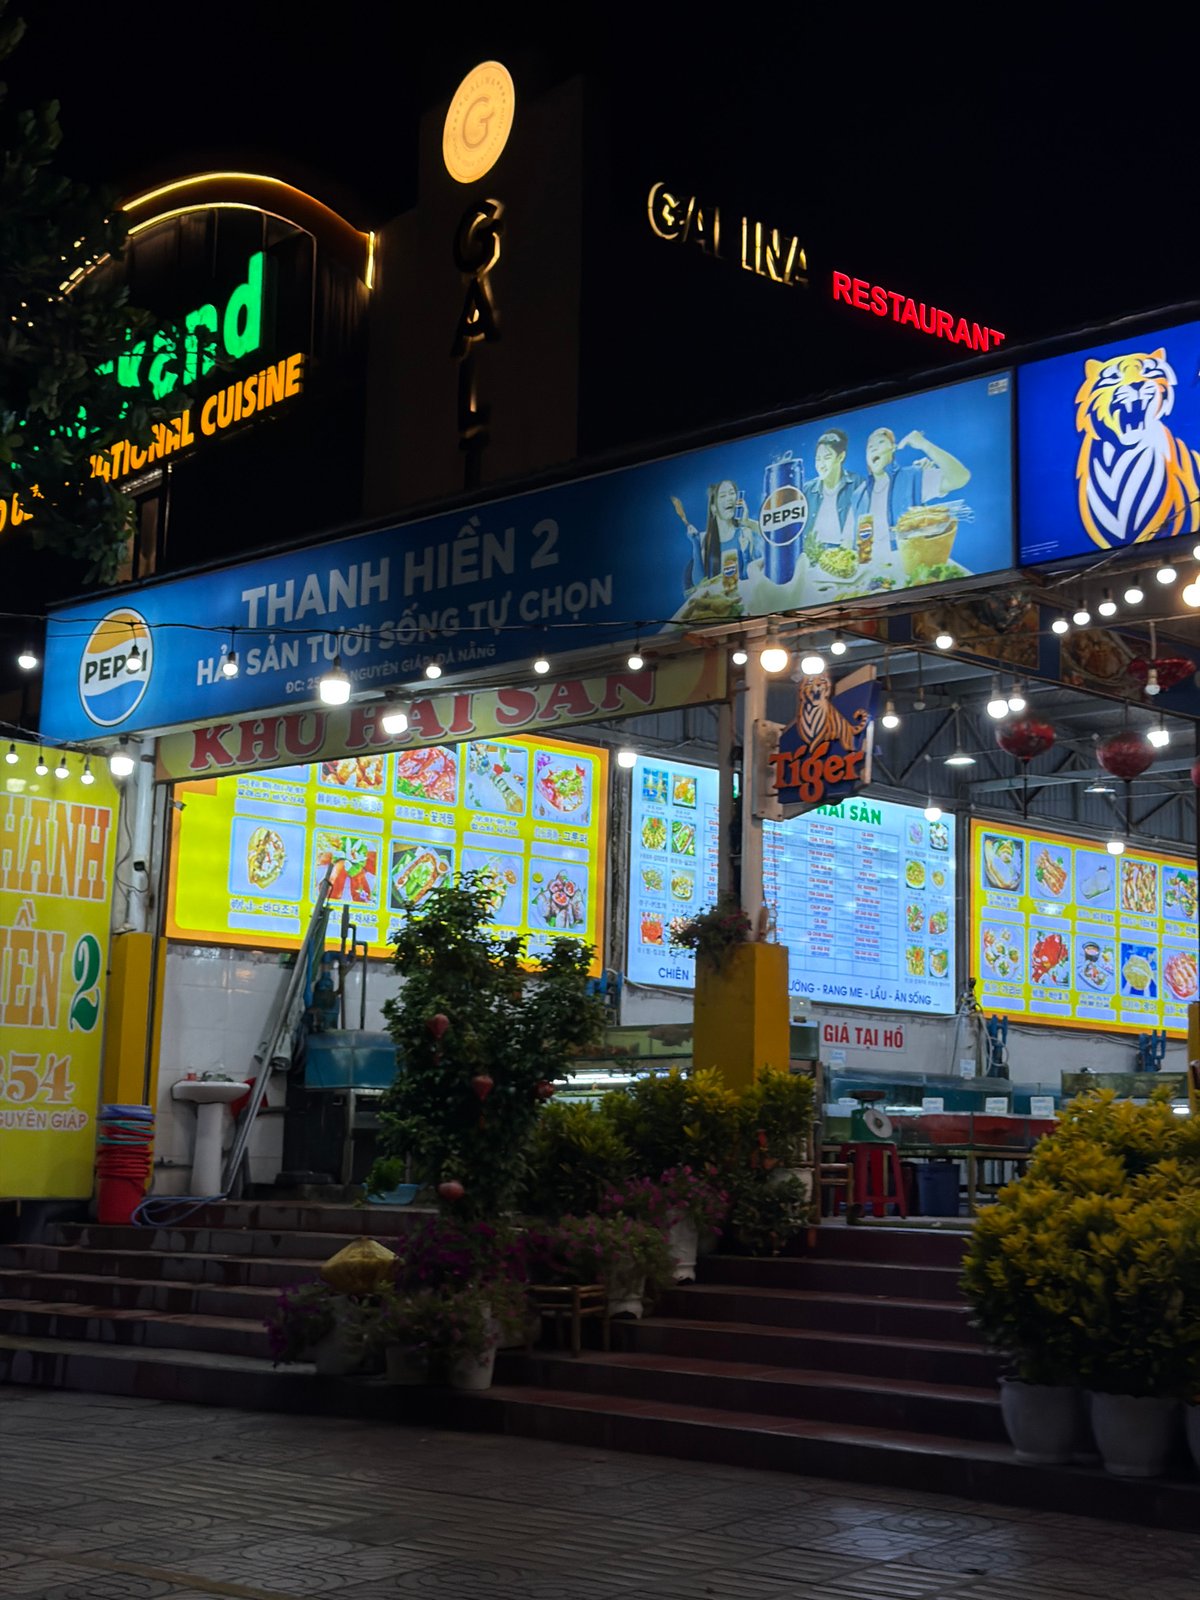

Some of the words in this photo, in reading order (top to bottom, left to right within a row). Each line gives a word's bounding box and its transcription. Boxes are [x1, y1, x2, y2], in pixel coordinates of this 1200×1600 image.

[832, 270, 1005, 352] RESTAURANT
[200, 353, 303, 437] CUISINE
[762, 505, 806, 527] PEPSI
[242, 557, 389, 629] THANH
[404, 515, 515, 597] HIỀN
[531, 518, 560, 569] 2
[246, 634, 299, 676] SẢN
[306, 623, 371, 664] TƯƠI
[379, 602, 459, 650] SỐNG
[468, 591, 511, 635] TỰ
[519, 574, 613, 621] CHỌN
[190, 710, 328, 771] KHU
[768, 741, 864, 803] Tiger
[850, 802, 882, 825] SẢN
[69, 933, 102, 1033] 2
[658, 966, 689, 981] CHIÊN
[823, 984, 848, 996] RANG
[850, 987, 863, 998] ME
[824, 1022, 850, 1044] GIÁ
[855, 1027, 879, 1049] TẠI
[884, 1025, 904, 1048] HỒ
